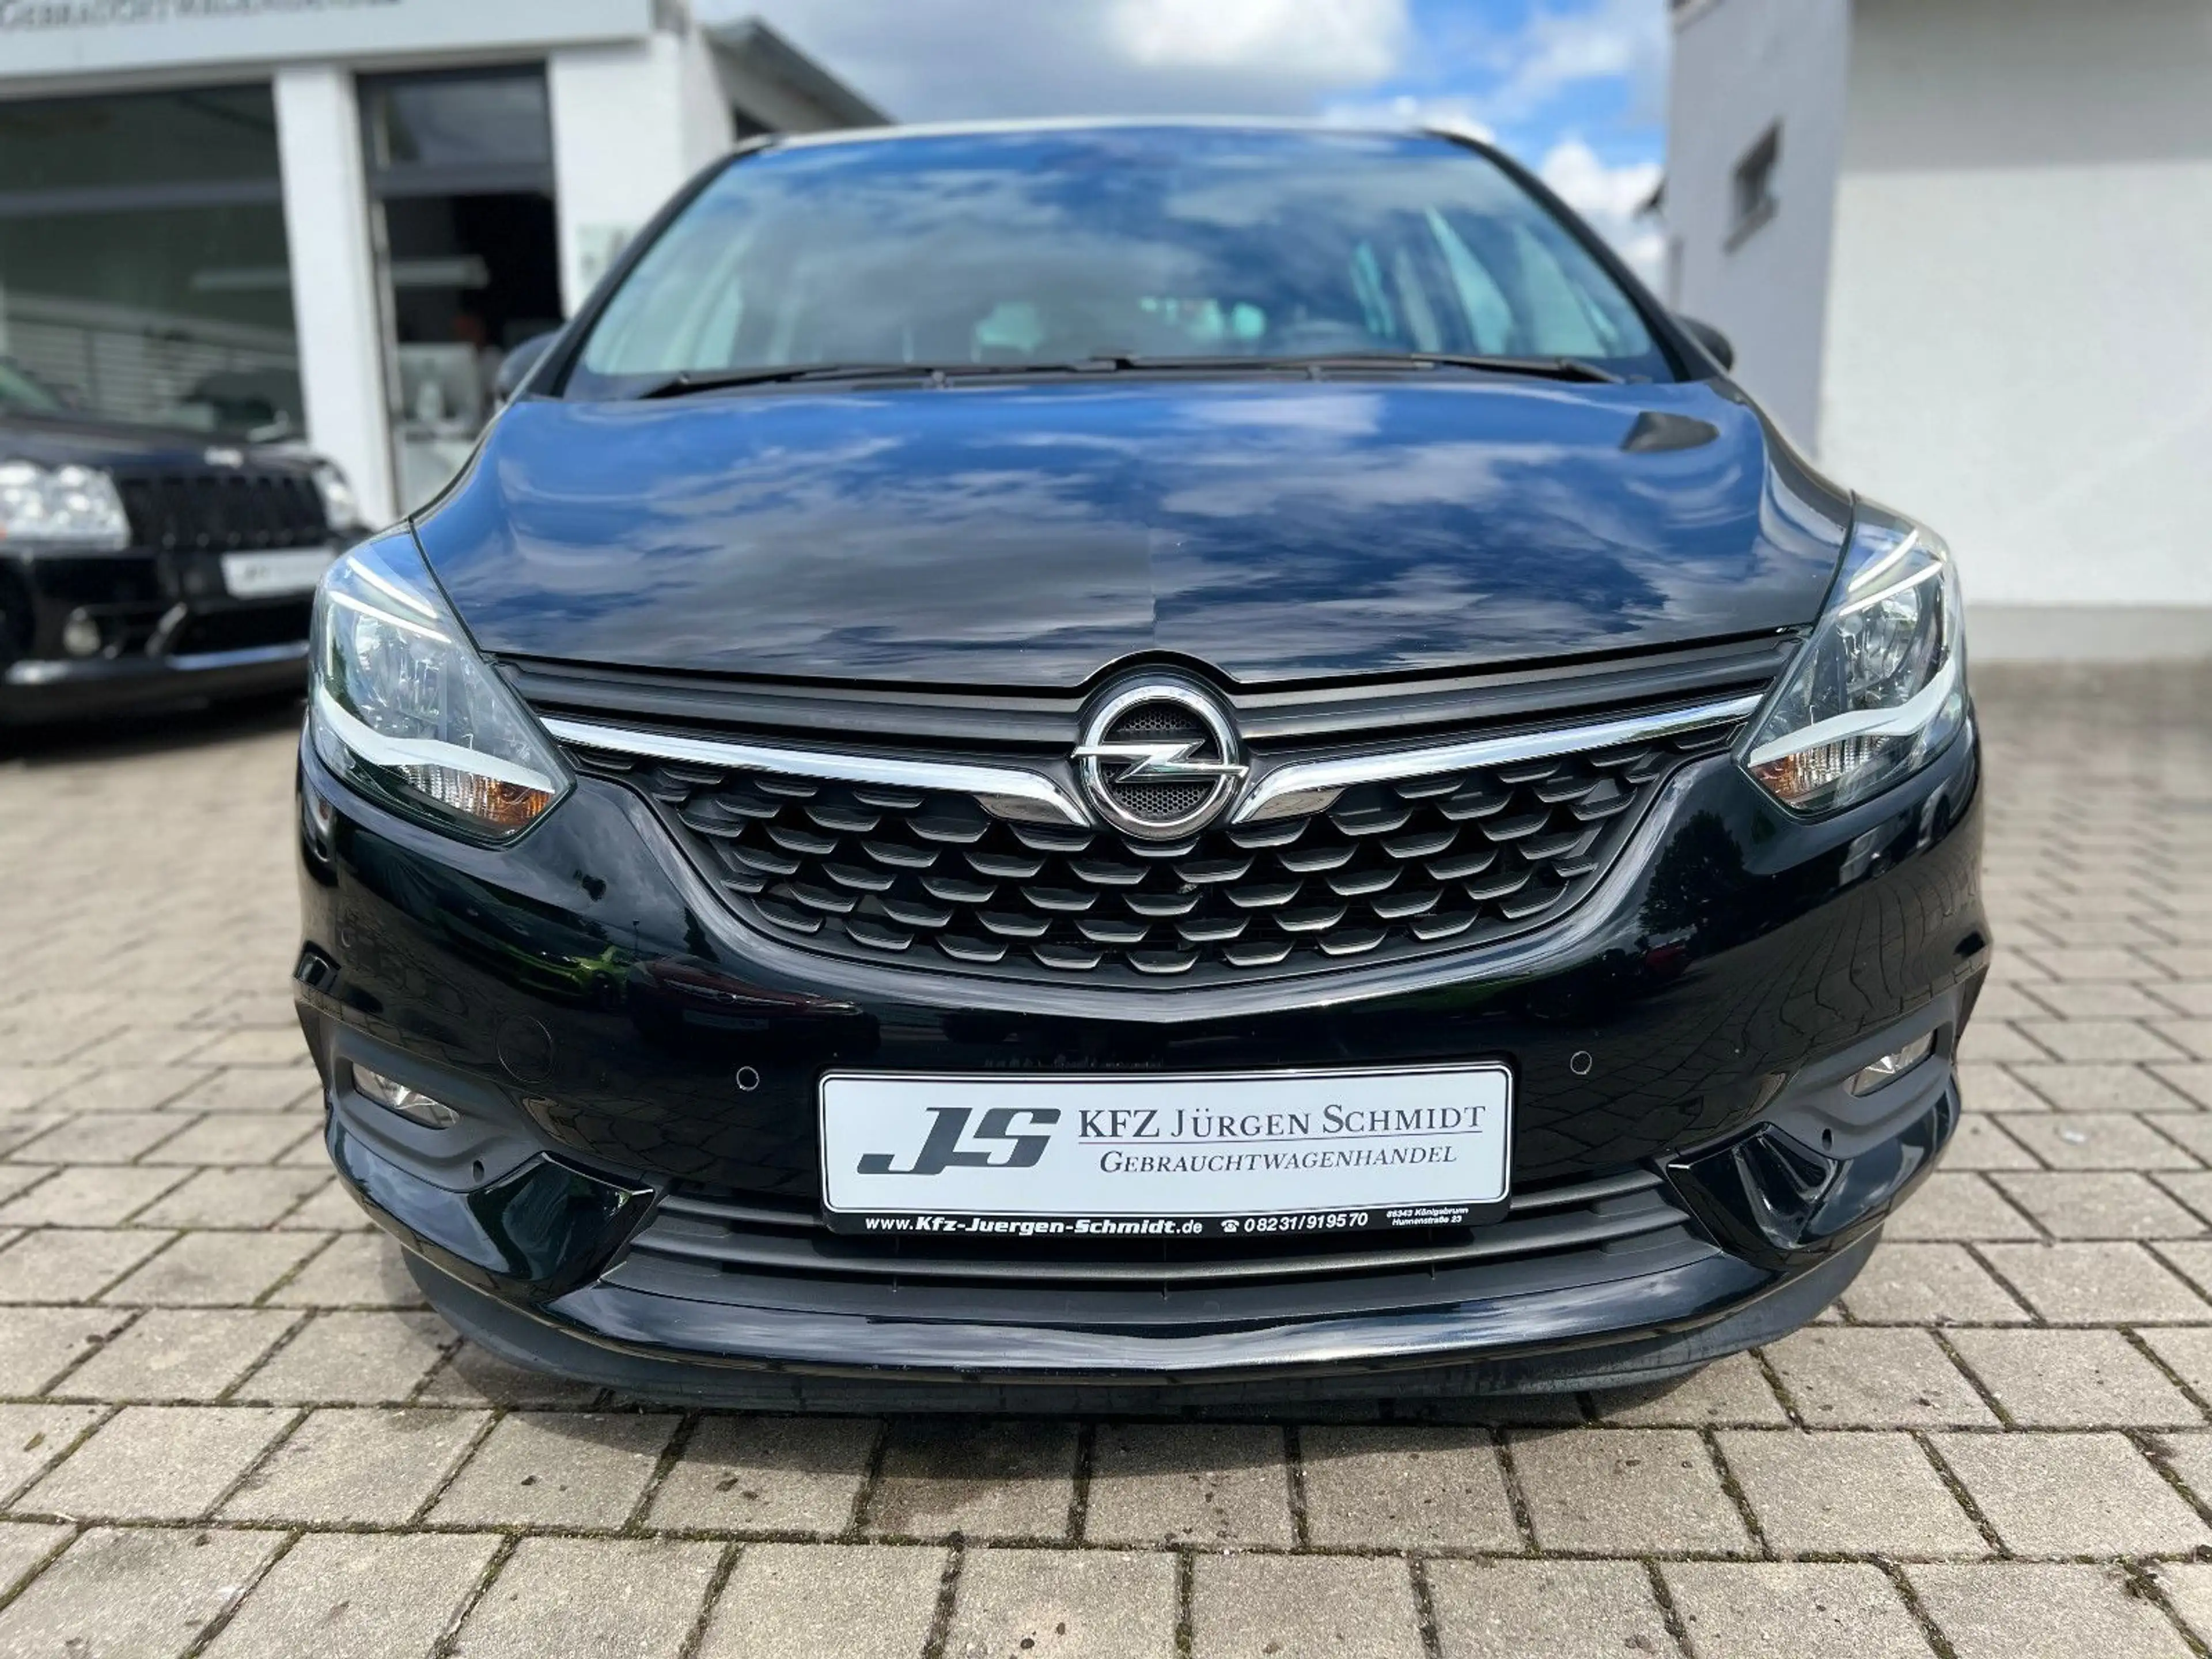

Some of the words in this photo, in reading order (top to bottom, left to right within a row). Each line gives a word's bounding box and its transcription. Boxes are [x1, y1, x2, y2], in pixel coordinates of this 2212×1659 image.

[1079, 1109, 1160, 1138] KFZ
[1171, 1108, 1311, 1137] JÜRGEN
[1323, 1104, 1486, 1133] SCHMIDT
[857, 1107, 1061, 1176] JS
[1100, 1145, 1458, 1173] GEBRAUCHTWAGENHANDEL
[865, 1216, 1203, 1236] www.Kfz-Juergen-Schmidt.de
[1244, 1213, 1368, 1232] 08231/919570
